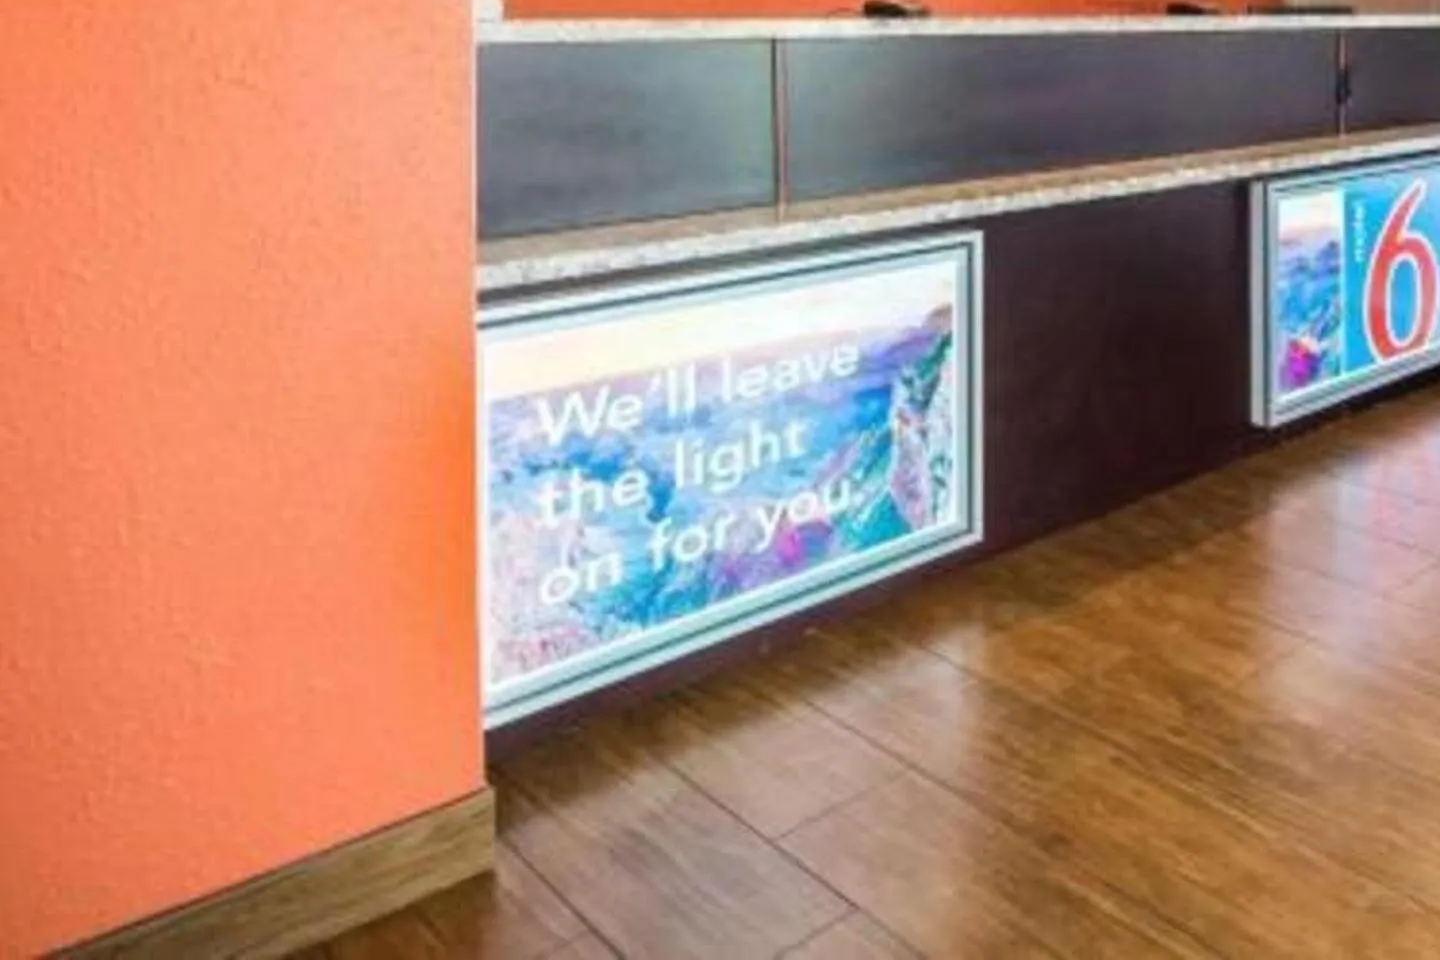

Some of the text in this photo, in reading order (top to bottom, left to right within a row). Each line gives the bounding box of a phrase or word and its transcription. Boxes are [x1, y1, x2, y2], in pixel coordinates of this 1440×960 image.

[1363, 178, 1440, 365] 6
[536, 343, 861, 448] We'll leave
[535, 418, 812, 528] the light
[538, 550, 624, 606] on
[647, 511, 737, 573] for
